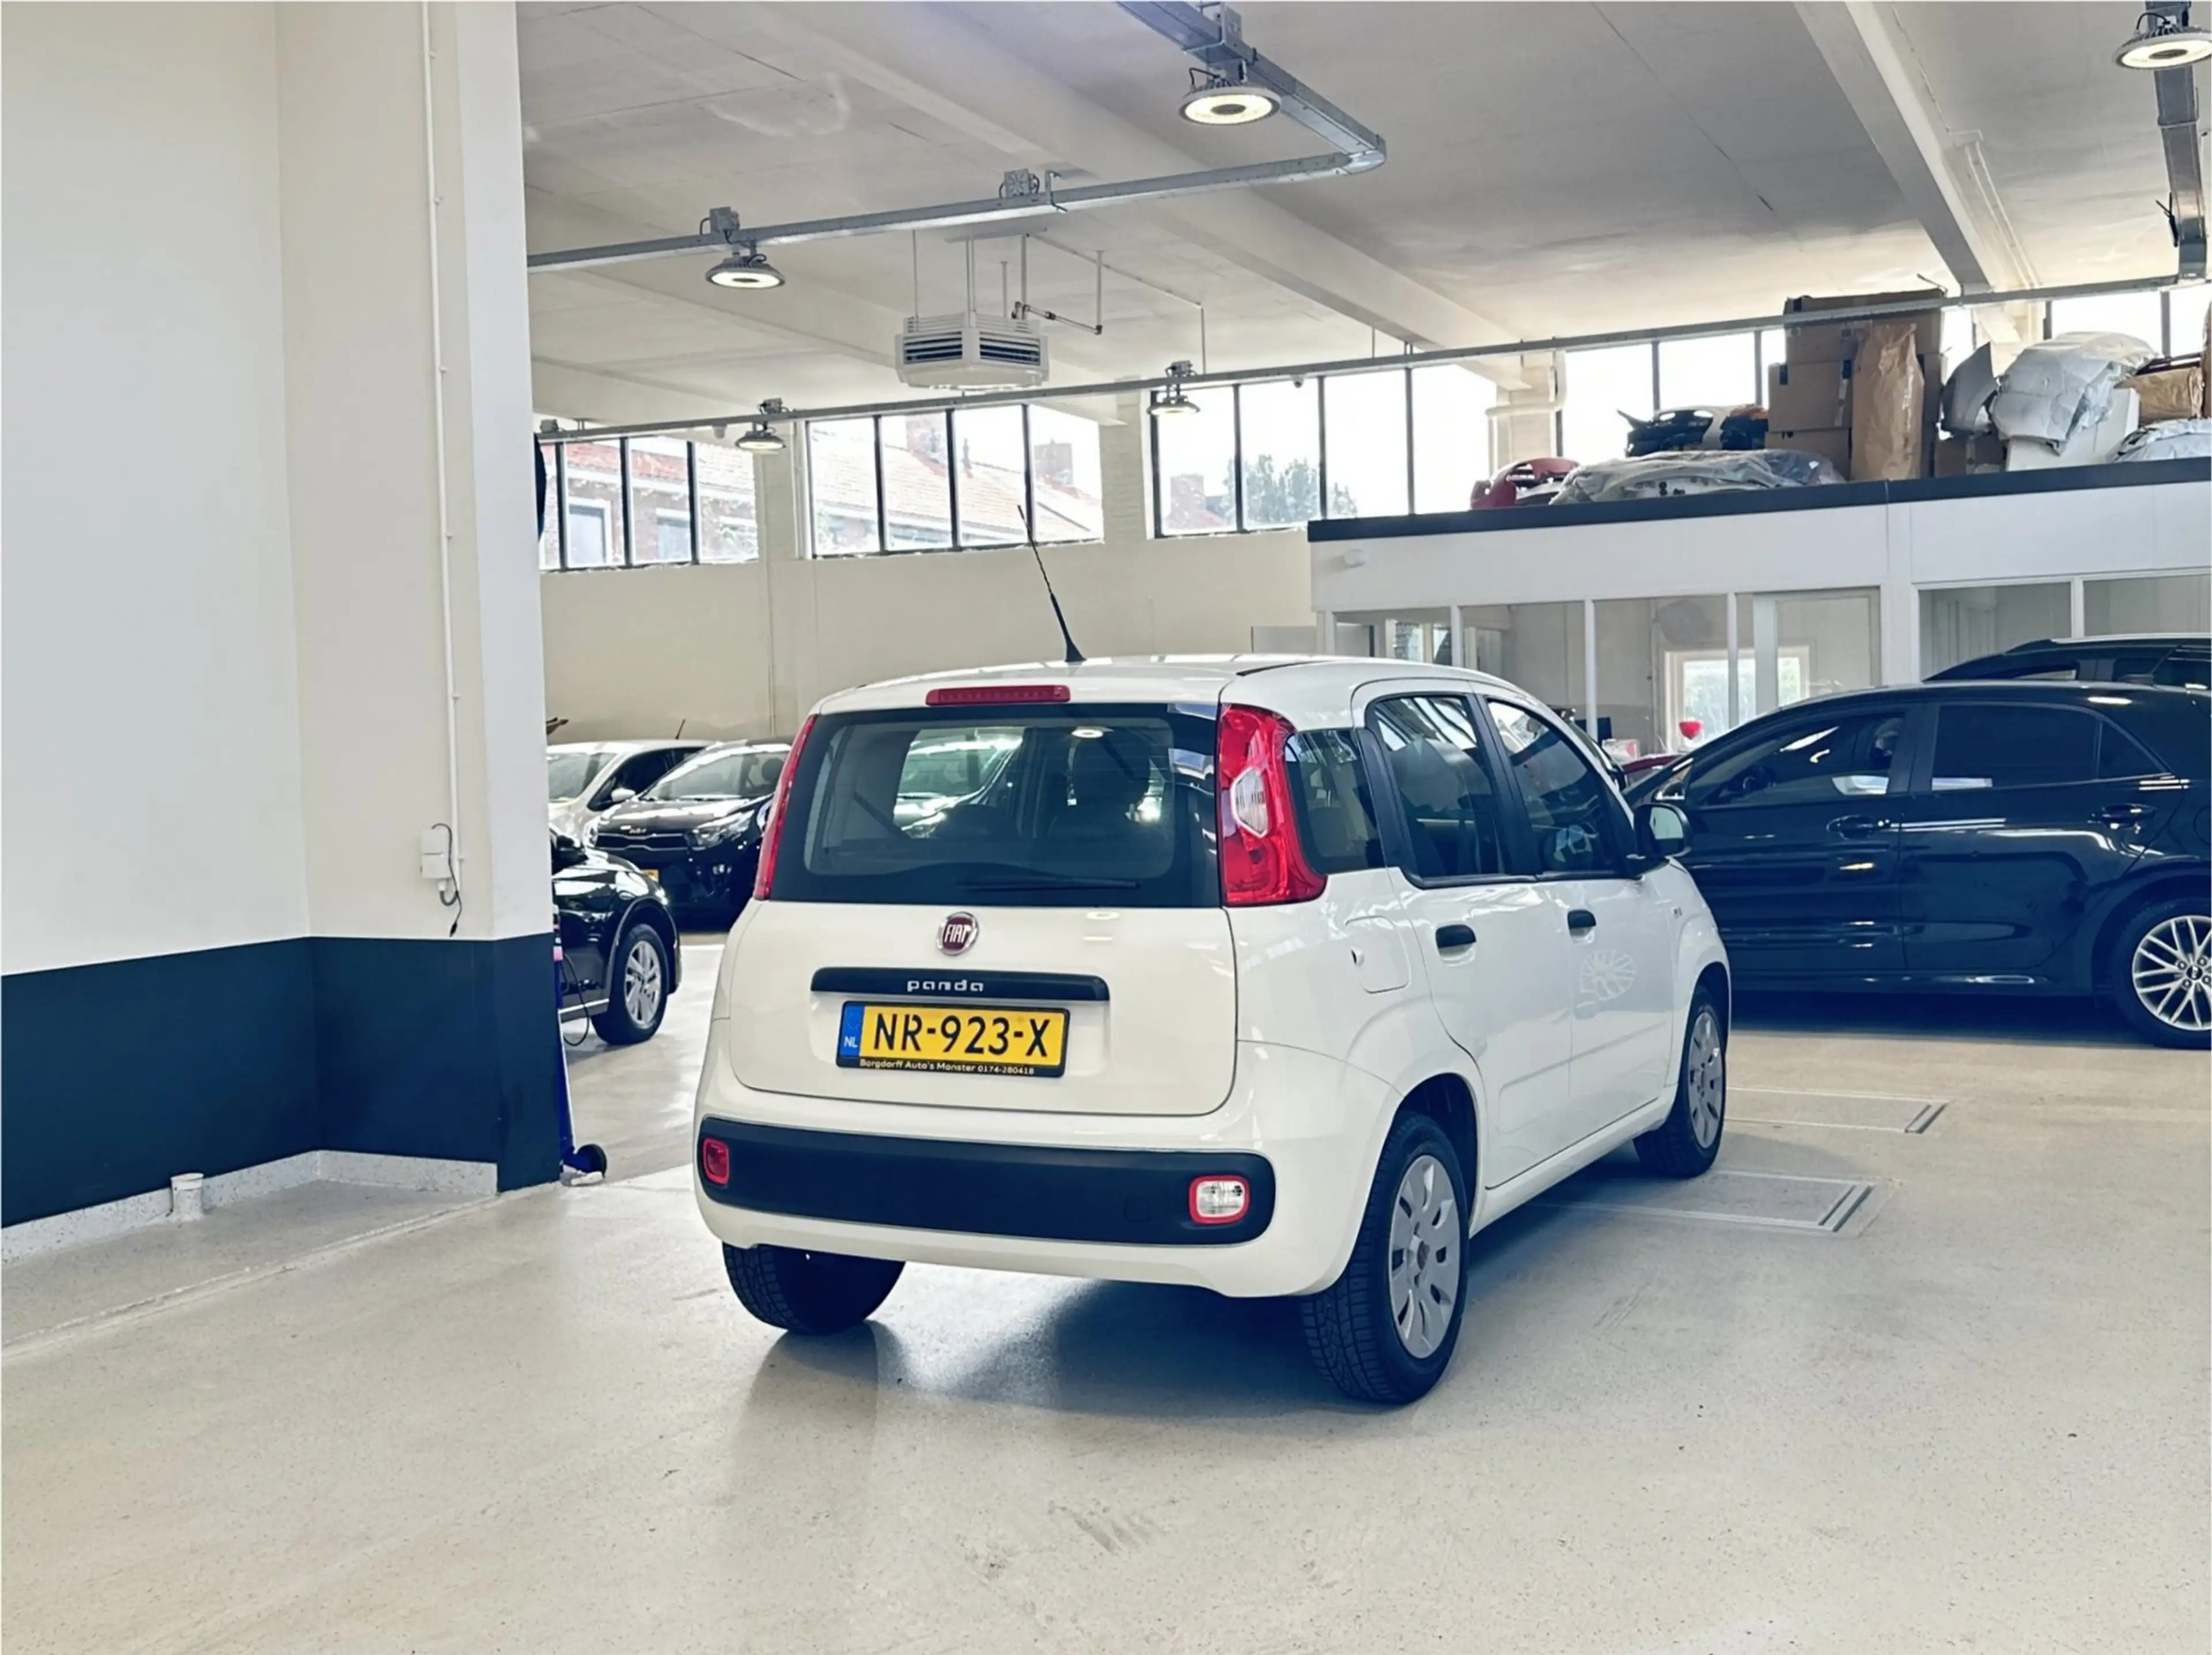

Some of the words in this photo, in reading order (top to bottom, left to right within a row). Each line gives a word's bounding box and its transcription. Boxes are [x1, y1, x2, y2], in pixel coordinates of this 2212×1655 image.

[944, 924, 972, 943] FIAT
[907, 979, 984, 993] panda
[843, 1036, 858, 1048] NL
[873, 1013, 1051, 1058] NR-923-X
[860, 1059, 903, 1069] Borgdorff
[904, 1061, 934, 1070] Auto's
[937, 1062, 976, 1071] Monster
